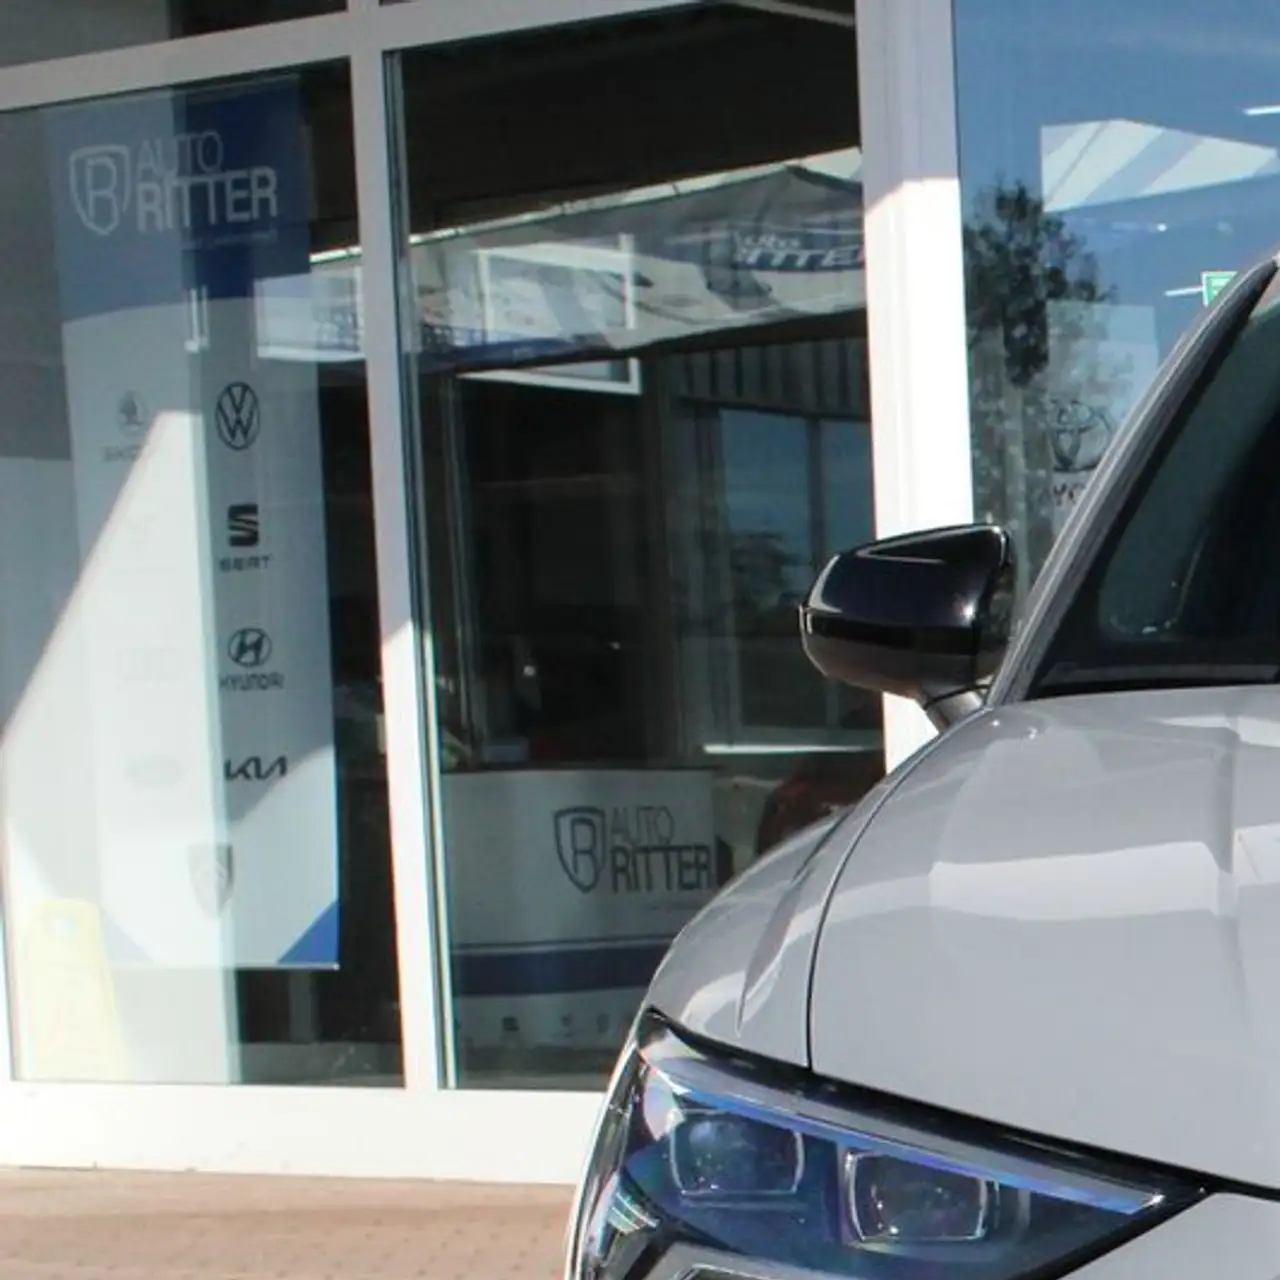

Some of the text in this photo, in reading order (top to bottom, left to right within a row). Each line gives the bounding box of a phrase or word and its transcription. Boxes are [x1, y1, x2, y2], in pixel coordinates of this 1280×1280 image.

[137, 131, 224, 177] AUTO
[136, 166, 278, 233] RITTER
[612, 805, 676, 845] AUTO
[610, 844, 712, 893] RITTER
